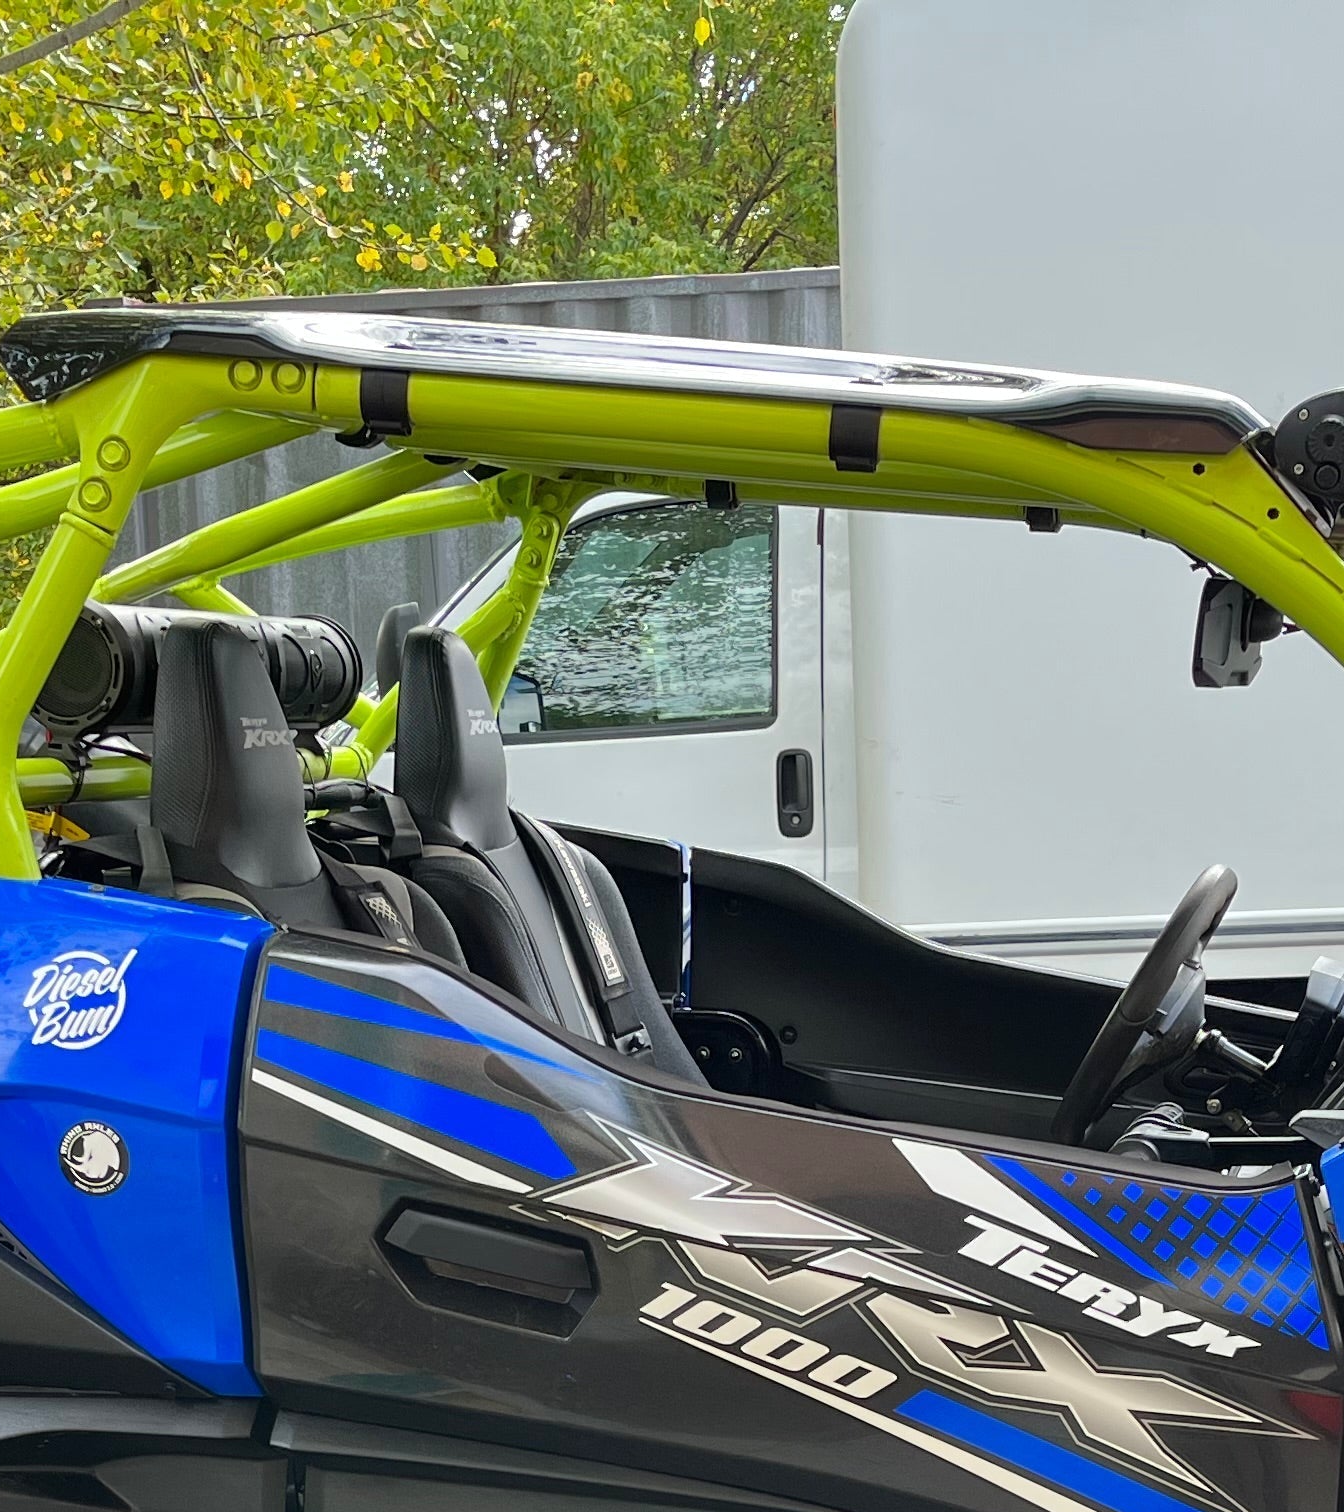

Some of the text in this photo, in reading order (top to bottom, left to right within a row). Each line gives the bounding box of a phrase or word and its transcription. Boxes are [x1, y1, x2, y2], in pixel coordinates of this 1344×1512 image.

[243, 728, 291, 750] KRX
[470, 719, 499, 736] KRX
[23, 949, 138, 1008] Diesel
[32, 1001, 116, 1046] Bum
[958, 1214, 1262, 1358] TERYX
[544, 1142, 1266, 1493] KRX
[639, 1281, 898, 1400] 1000
